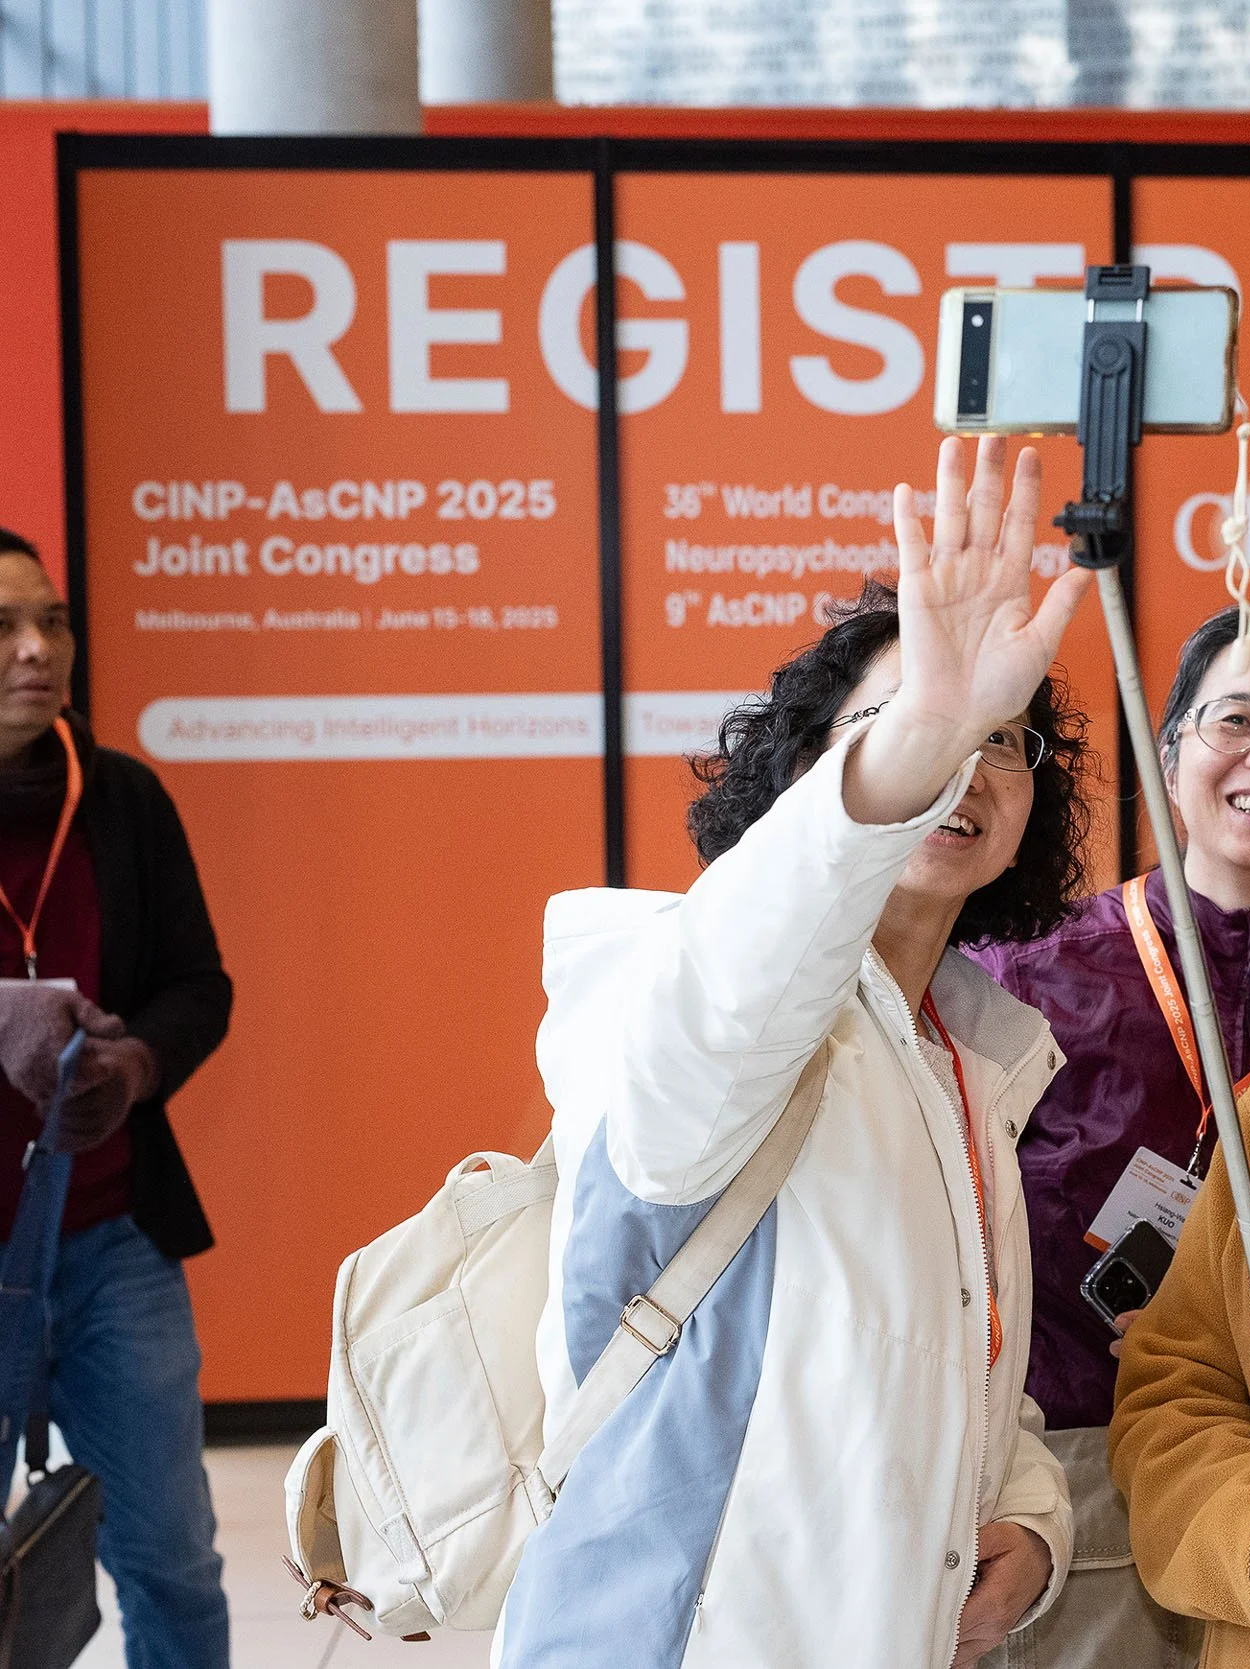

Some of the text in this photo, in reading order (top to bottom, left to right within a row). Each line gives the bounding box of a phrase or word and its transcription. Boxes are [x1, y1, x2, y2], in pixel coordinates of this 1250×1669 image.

[133, 479, 557, 521] CINP-AsCNP 2025
[723, 485, 812, 518] World
[133, 535, 480, 584] Joint Congress
[707, 592, 806, 626] AsCNP
[1158, 974, 1175, 998] Joint
[1166, 996, 1184, 1025] 2025
[1158, 1215, 1175, 1228] KUO
